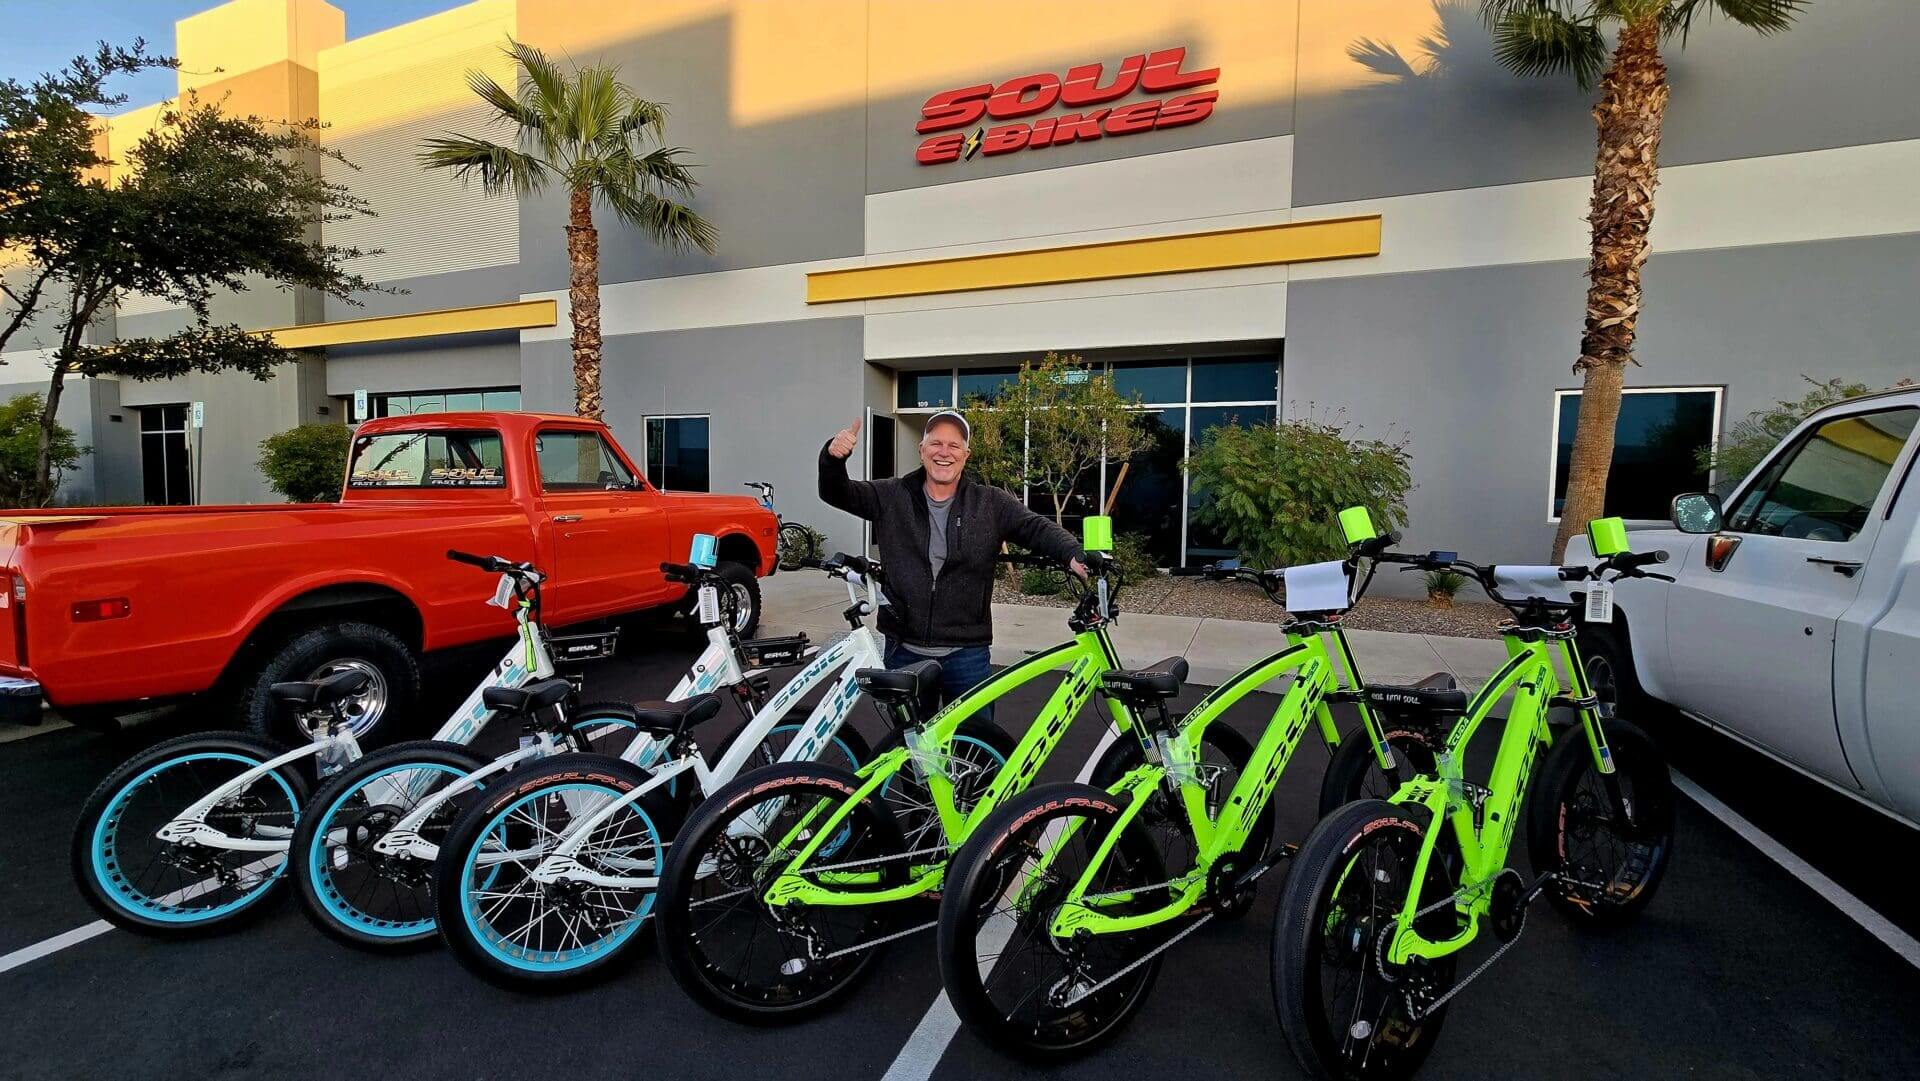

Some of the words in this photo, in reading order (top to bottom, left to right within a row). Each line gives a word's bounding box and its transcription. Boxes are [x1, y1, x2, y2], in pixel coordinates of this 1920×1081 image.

[915, 46, 1221, 134] SOUL
[351, 470, 416, 482] SOUL
[429, 468, 503, 480] SOUL
[773, 645, 845, 713] SONIC
[1182, 699, 1210, 727] CUDA
[1451, 717, 1470, 747] CUDA
[1241, 670, 1330, 833] SOUL
[519, 771, 585, 794] SOUL
[585, 772, 634, 791] FAS
[752, 776, 816, 795] SOUL
[1010, 800, 1064, 834] SOUL
[1064, 797, 1118, 814] FAST
[1363, 817, 1402, 836] SOUL
